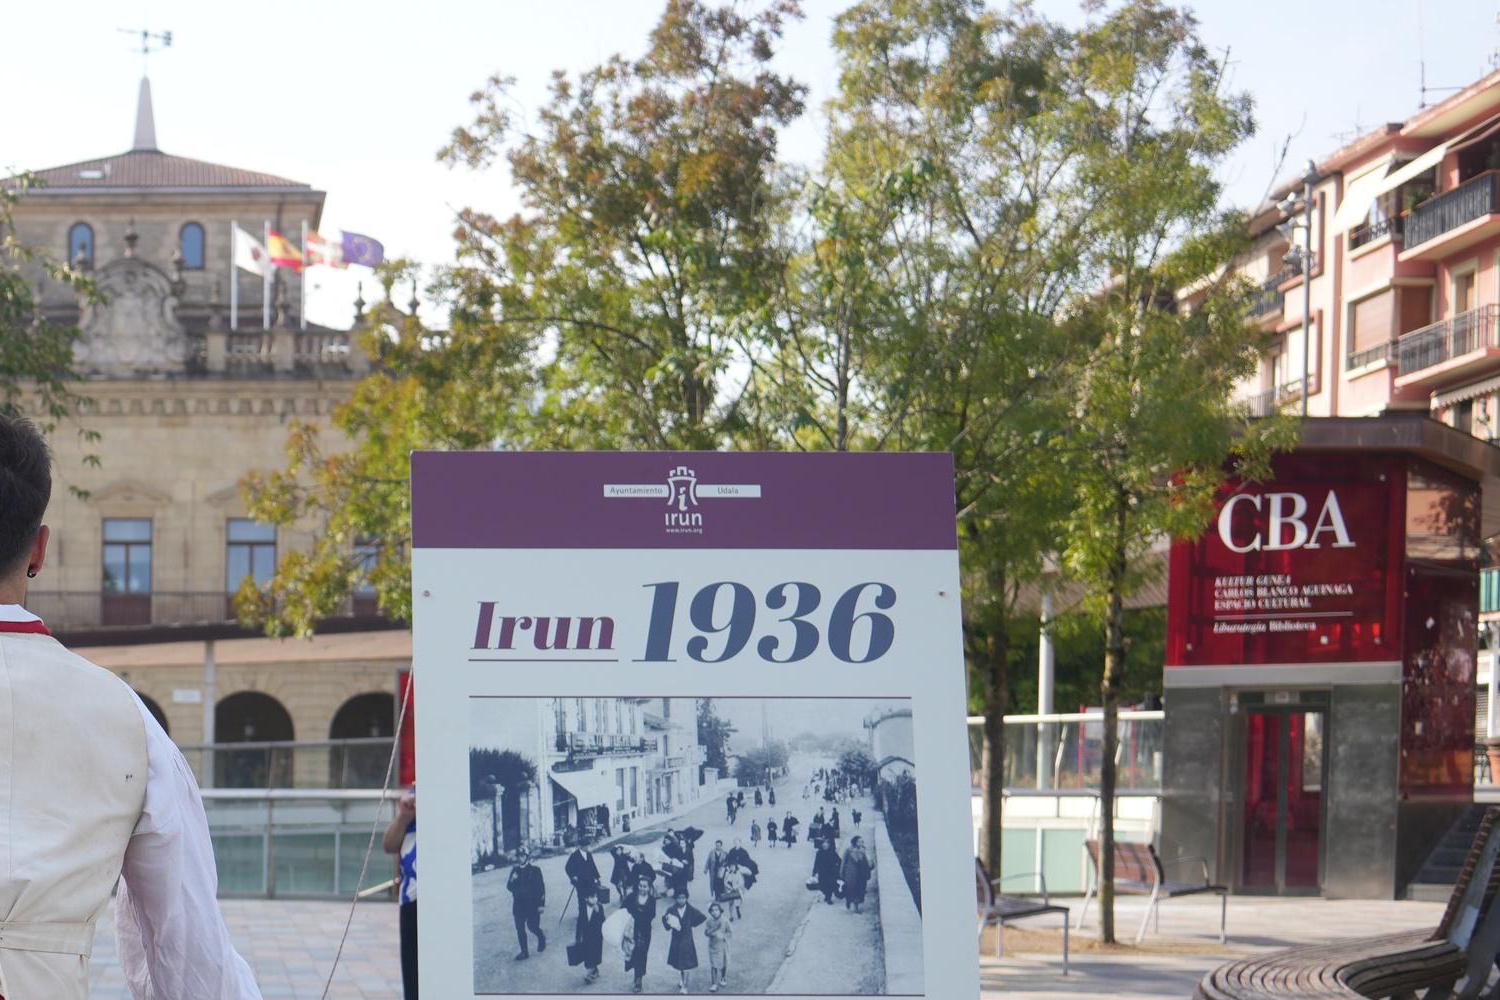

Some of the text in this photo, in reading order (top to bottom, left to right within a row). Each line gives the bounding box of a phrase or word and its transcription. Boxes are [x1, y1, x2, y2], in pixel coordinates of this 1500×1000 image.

[610, 486, 739, 495] Ayuntamiento Udala
[665, 512, 703, 526] irun
[1217, 489, 1357, 554] CBA
[1214, 575, 1255, 588] KULTUR
[1214, 587, 1255, 599] CARLOS
[1256, 585, 1299, 597] BLANCO
[1214, 597, 1312, 611] ESPACIO CULTURAL
[469, 581, 897, 664] Irun 1936
[1269, 620, 1317, 631] Biblioteca
